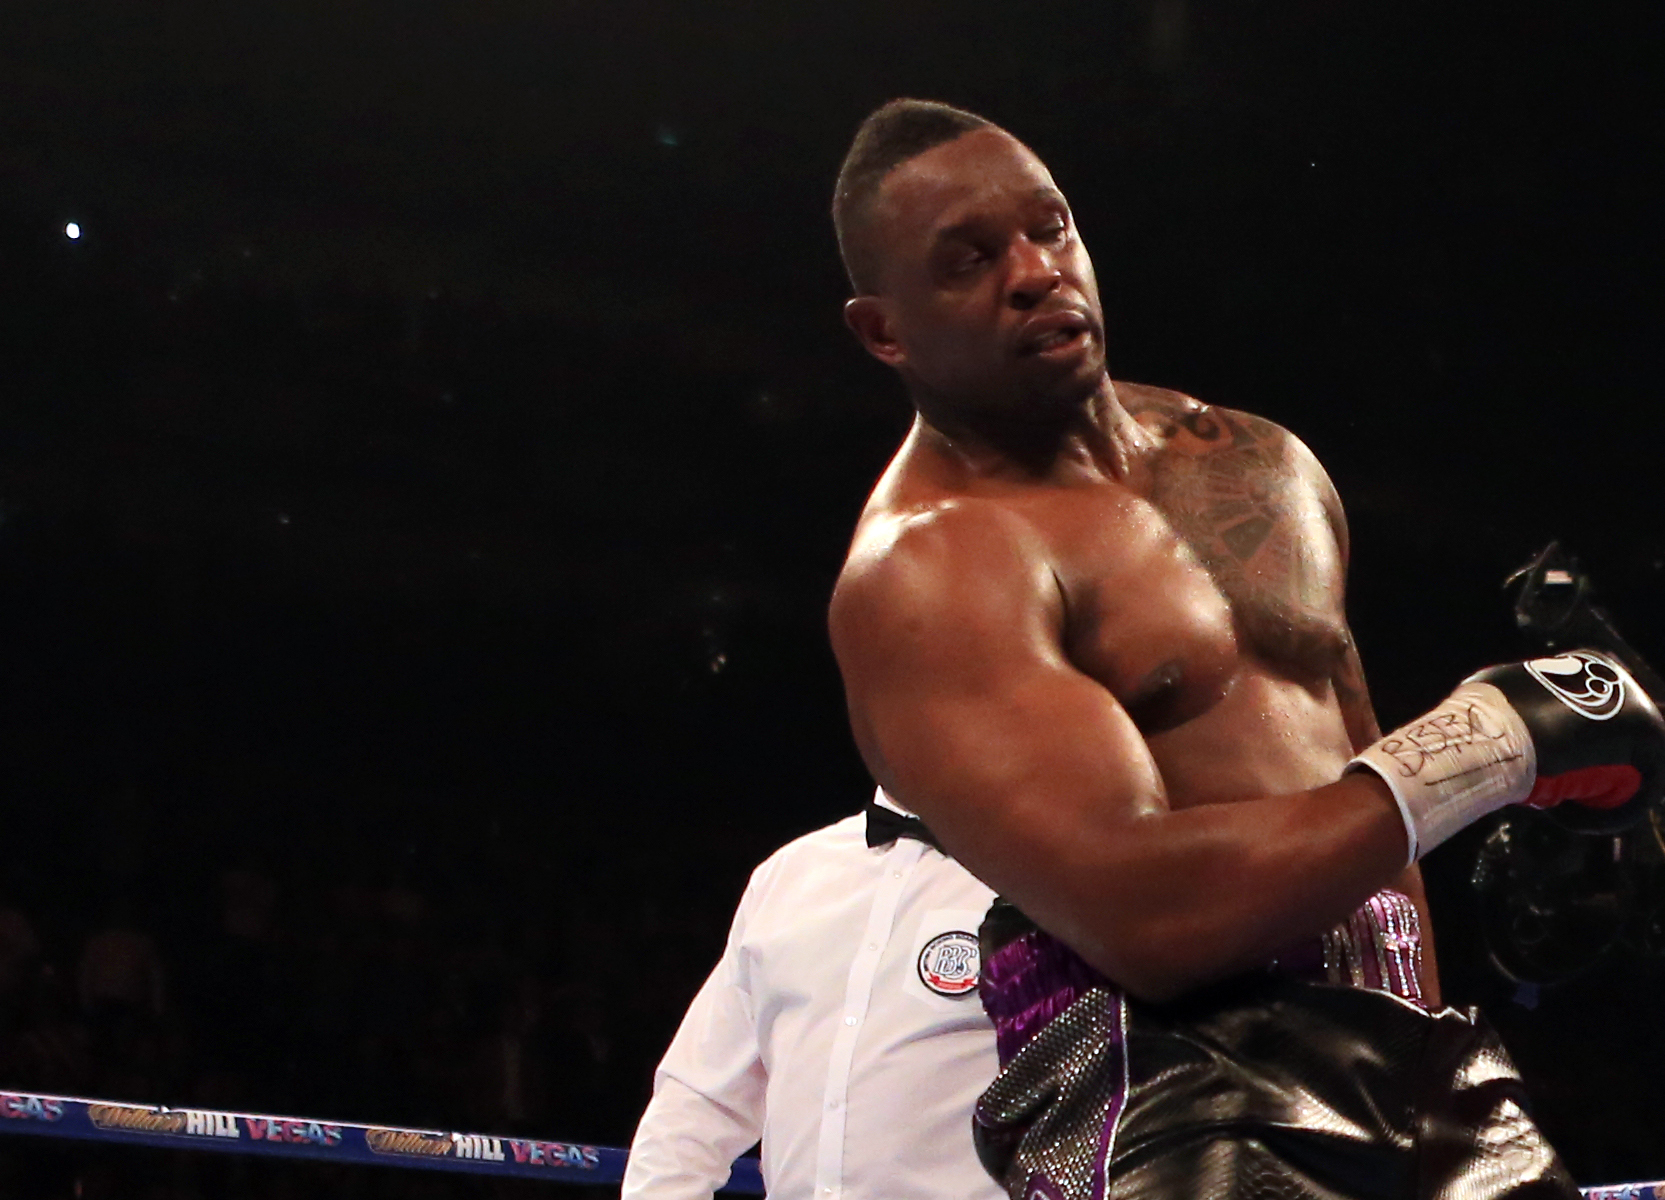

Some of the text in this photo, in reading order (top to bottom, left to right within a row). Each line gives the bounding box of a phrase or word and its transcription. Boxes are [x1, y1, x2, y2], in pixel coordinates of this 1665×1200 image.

[185, 1111, 241, 1139] HILL
[245, 1117, 344, 1147] VEGAS
[454, 1134, 506, 1162] HILL
[508, 1139, 600, 1170] VEGAS
